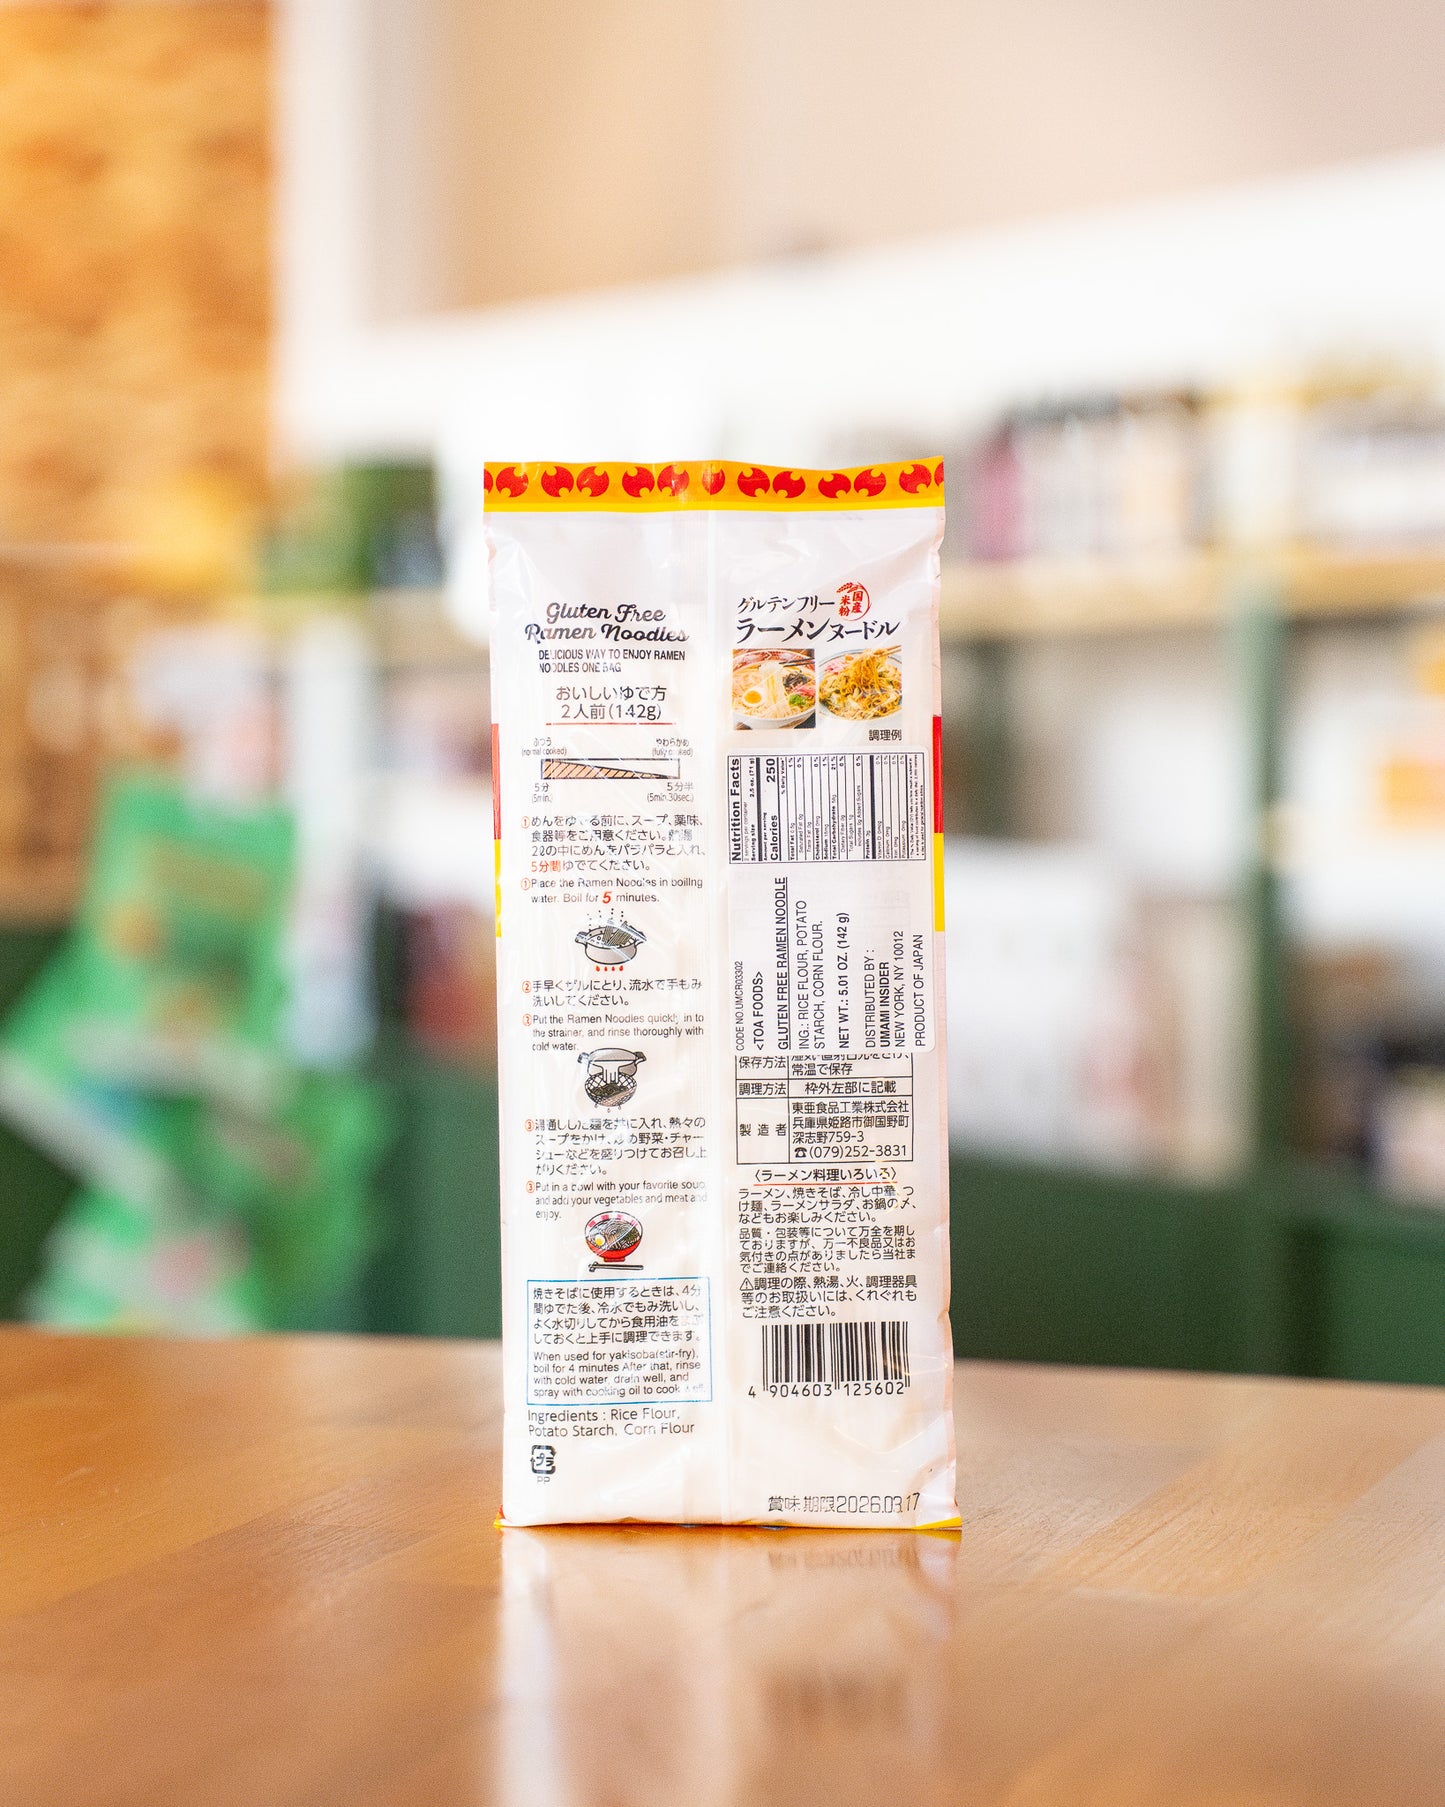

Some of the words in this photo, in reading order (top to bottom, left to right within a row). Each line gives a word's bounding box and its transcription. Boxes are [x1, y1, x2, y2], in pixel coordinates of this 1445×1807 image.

[738, 595, 835, 613] グルテンフリー
[839, 596, 851, 616] 米粉
[852, 591, 863, 613] 国産
[547, 602, 611, 624] Gluten
[615, 604, 666, 622] Free
[525, 624, 596, 644] Ramen
[601, 624, 689, 641] Noodles
[737, 618, 900, 643] ラーメンヌードル
[539, 650, 583, 660] DELICIOUS
[586, 650, 606, 659] WAY
[609, 649, 620, 659] TO
[623, 650, 651, 659] ENJOY
[654, 651, 685, 660] RAMEN
[540, 663, 579, 672] NOODLES
[582, 663, 600, 672] ONE
[556, 686, 667, 701] おいしいゆで方
[868, 729, 902, 741] 調理例
[730, 758, 739, 796] Facts
[766, 758, 775, 782] 250
[731, 801, 741, 861] Nutrition
[770, 815, 778, 860] Calories
[660, 878, 668, 886] in
[563, 894, 582, 902] Boil
[586, 893, 598, 902] for
[602, 891, 612, 904] 5
[616, 894, 659, 902] minutes.
[775, 877, 786, 924] NOODLE
[796, 901, 807, 946] POTATO
[836, 913, 849, 922] g)
[812, 921, 823, 960] FLOUR.
[837, 927, 850, 949] (142
[893, 931, 903, 961] 10012
[776, 927, 787, 968] RAMEN
[913, 935, 923, 970] JAPAN
[797, 949, 809, 989] FLOUR,
[838, 952, 848, 970] OZ.
[864, 956, 874, 970] BY
[814, 964, 823, 997] CORN
[894, 965, 904, 980] NY
[777, 972, 787, 1001] FREE
[839, 975, 848, 995] 5.01
[880, 962, 889, 1007] INSIDER
[913, 974, 924, 989] OF
[753, 971, 763, 1017] FOODS>
[894, 984, 904, 1017] YORK,
[798, 994, 808, 1020] RICE
[839, 999, 849, 1023] WT.:
[864, 974, 876, 1047] DISTRIBUTED
[533, 1015, 547, 1024] Put
[550, 1015, 563, 1023] the
[568, 1015, 601, 1023] Ramen
[605, 1015, 644, 1023] Noodles
[684, 1014, 692, 1022] in
[695, 1014, 704, 1022] to
[778, 1004, 789, 1050] GLUTEN
[815, 1001, 825, 1049] STARCH,
[914, 992, 925, 1046] PRODUCT
[548, 1028, 584, 1037] strainer,
[588, 1028, 604, 1036] and
[608, 1028, 630, 1036] rinse
[634, 1027, 682, 1037] thoroughly
[686, 1026, 703, 1035] with
[754, 1021, 764, 1050] <TOA
[798, 1023, 809, 1049] ING.:
[880, 1011, 890, 1047] UMAMI
[894, 1021, 905, 1047] NEW
[736, 1027, 744, 1050] CODE
[839, 1027, 849, 1048] NET
[532, 1042, 549, 1051] cold
[739, 1056, 786, 1068] 保存方法
[792, 1063, 853, 1076] 常温で保存
[739, 1083, 786, 1095] 調理方法
[805, 1081, 896, 1094] 枠外左部に記載
[792, 1100, 909, 1114] 東亜食品工業株式会社
[793, 1115, 909, 1129] 兵庫県姫路市御国野町
[792, 1131, 864, 1144] 深志野759-3
[755, 1167, 896, 1182] 〈ラーメン料理いろいろ〉
[536, 1182, 549, 1191] Put
[552, 1182, 560, 1191] in
[597, 1181, 615, 1191] with
[619, 1182, 639, 1192] your
[643, 1180, 678, 1190] favorite
[571, 1196, 591, 1207] your
[594, 1195, 643, 1207] vegetables
[645, 1194, 662, 1203] and
[665, 1194, 688, 1203] meat
[536, 1211, 561, 1221] enjoy.
[739, 1212, 876, 1224] などもお楽しみください。
[739, 1226, 914, 1239] 品質・包装等について万全を期し
[740, 1238, 915, 1250] ておりますが、万一不良品又はお
[740, 1249, 916, 1262] 気付きの点がありましたら当社ま
[740, 1262, 840, 1274] でご連絡ください。
[741, 1290, 917, 1305] 等のお取扱いには、くれぐれも
[742, 1305, 836, 1318] ご注意ください。
[534, 1352, 560, 1361] When
[564, 1351, 589, 1360] used
[593, 1351, 605, 1360] for
[534, 1364, 549, 1372] boil
[553, 1364, 566, 1372] for
[676, 1361, 700, 1370] rinse
[643, 1374, 666, 1382] well,
[670, 1372, 688, 1381] and
[534, 1389, 559, 1398] spray
[563, 1388, 582, 1396] with
[629, 1386, 640, 1395] oil
[643, 1385, 652, 1394] to
[748, 1386, 756, 1398] 4
[770, 1384, 832, 1398] 904603
[844, 1382, 904, 1396] 125602
[528, 1410, 598, 1424] Ingredients
[611, 1409, 637, 1419] Rice
[643, 1408, 680, 1419] Flour,
[529, 1425, 568, 1437] Potato
[573, 1425, 617, 1436] Starch,
[624, 1424, 656, 1435] Corn
[662, 1423, 694, 1433] Flour
